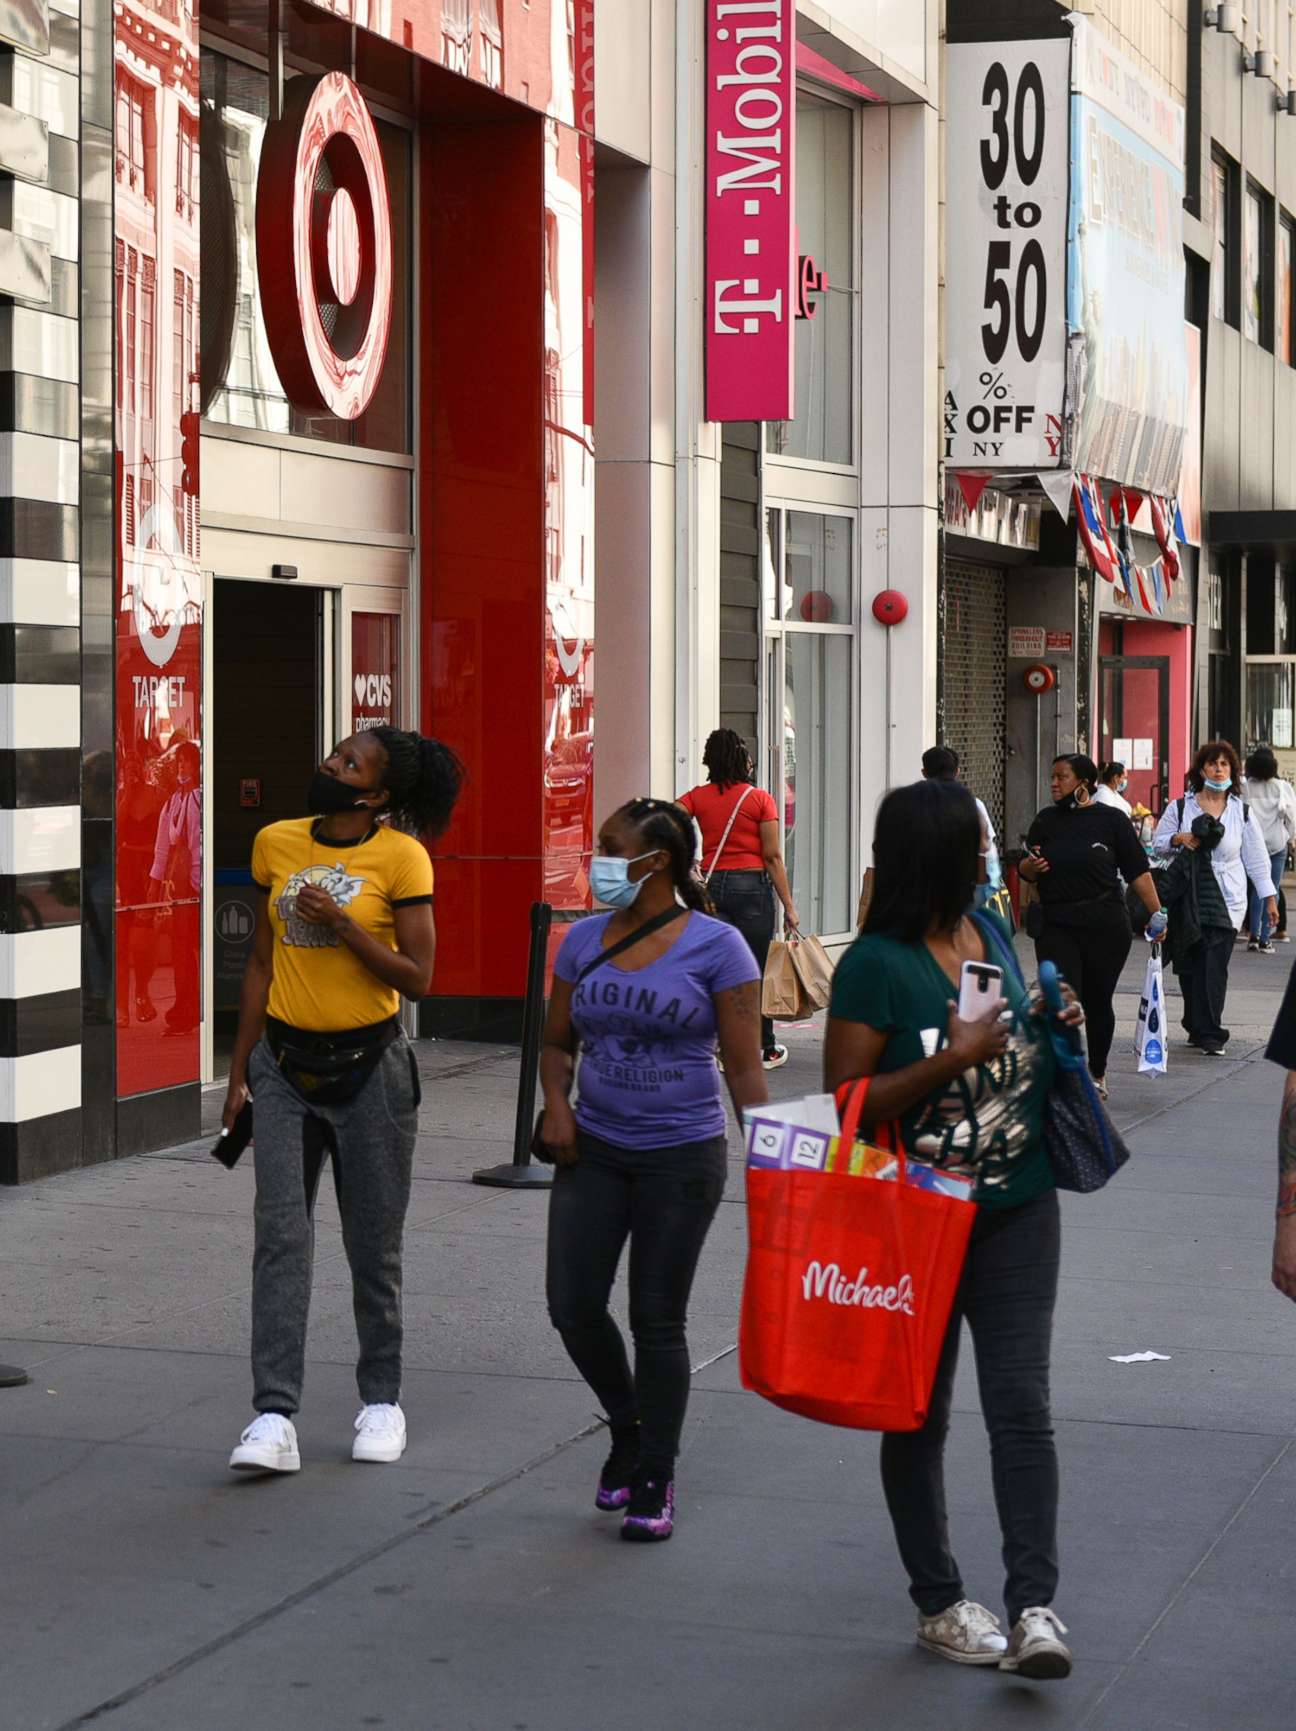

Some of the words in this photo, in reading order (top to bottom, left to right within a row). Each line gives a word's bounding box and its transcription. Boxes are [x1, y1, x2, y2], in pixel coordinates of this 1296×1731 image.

[980, 62, 1045, 190] 30
[993, 195, 1042, 229] to
[981, 238, 1047, 364] 50
[979, 372, 1007, 400] %
[966, 405, 1035, 434] OFF
[972, 442, 1004, 456] NY
[367, 674, 392, 708] CVS
[554, 684, 584, 708] TAGET
[575, 978, 701, 1029] RIGINAL
[799, 1140, 819, 1161] 12
